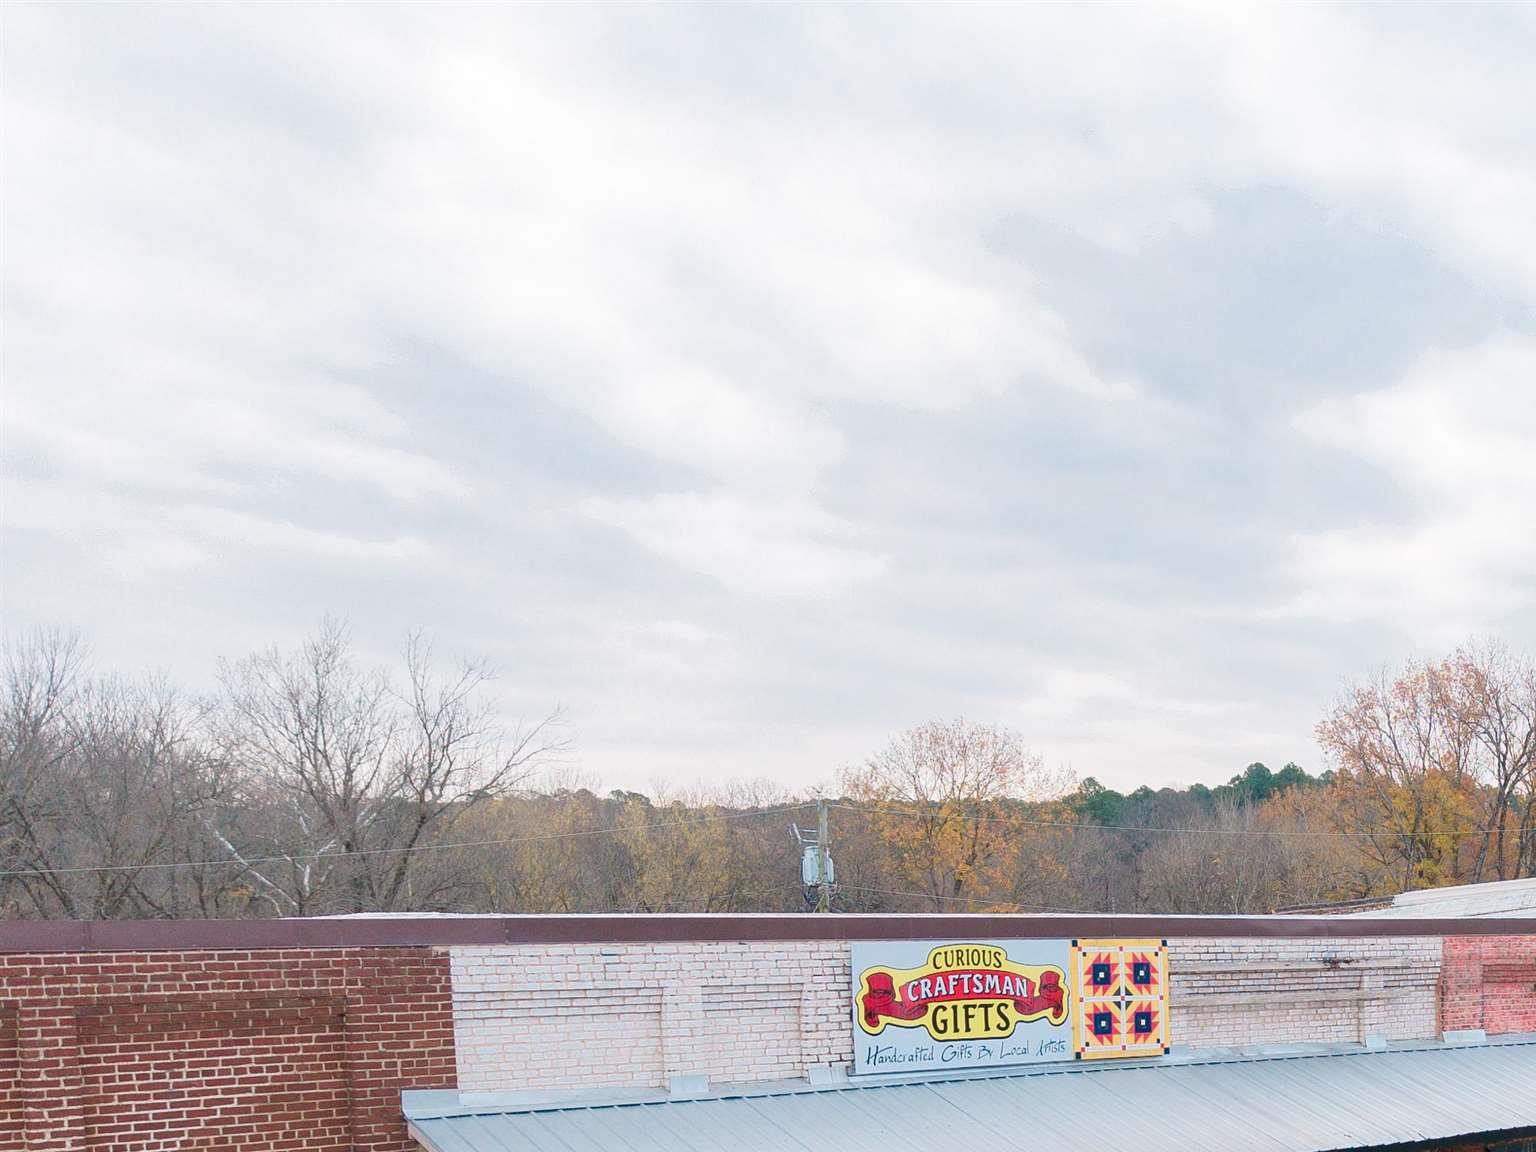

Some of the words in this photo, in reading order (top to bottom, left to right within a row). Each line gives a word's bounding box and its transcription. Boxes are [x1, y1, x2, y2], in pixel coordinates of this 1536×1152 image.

[932, 947, 1002, 970] CURIOUS
[907, 972, 1029, 1003] CRAFTSMAN
[931, 1002, 1011, 1034] GIFTS
[864, 1043, 935, 1067] Handcrafted
[941, 1042, 973, 1062] Gifts
[999, 1041, 1030, 1058] Local
